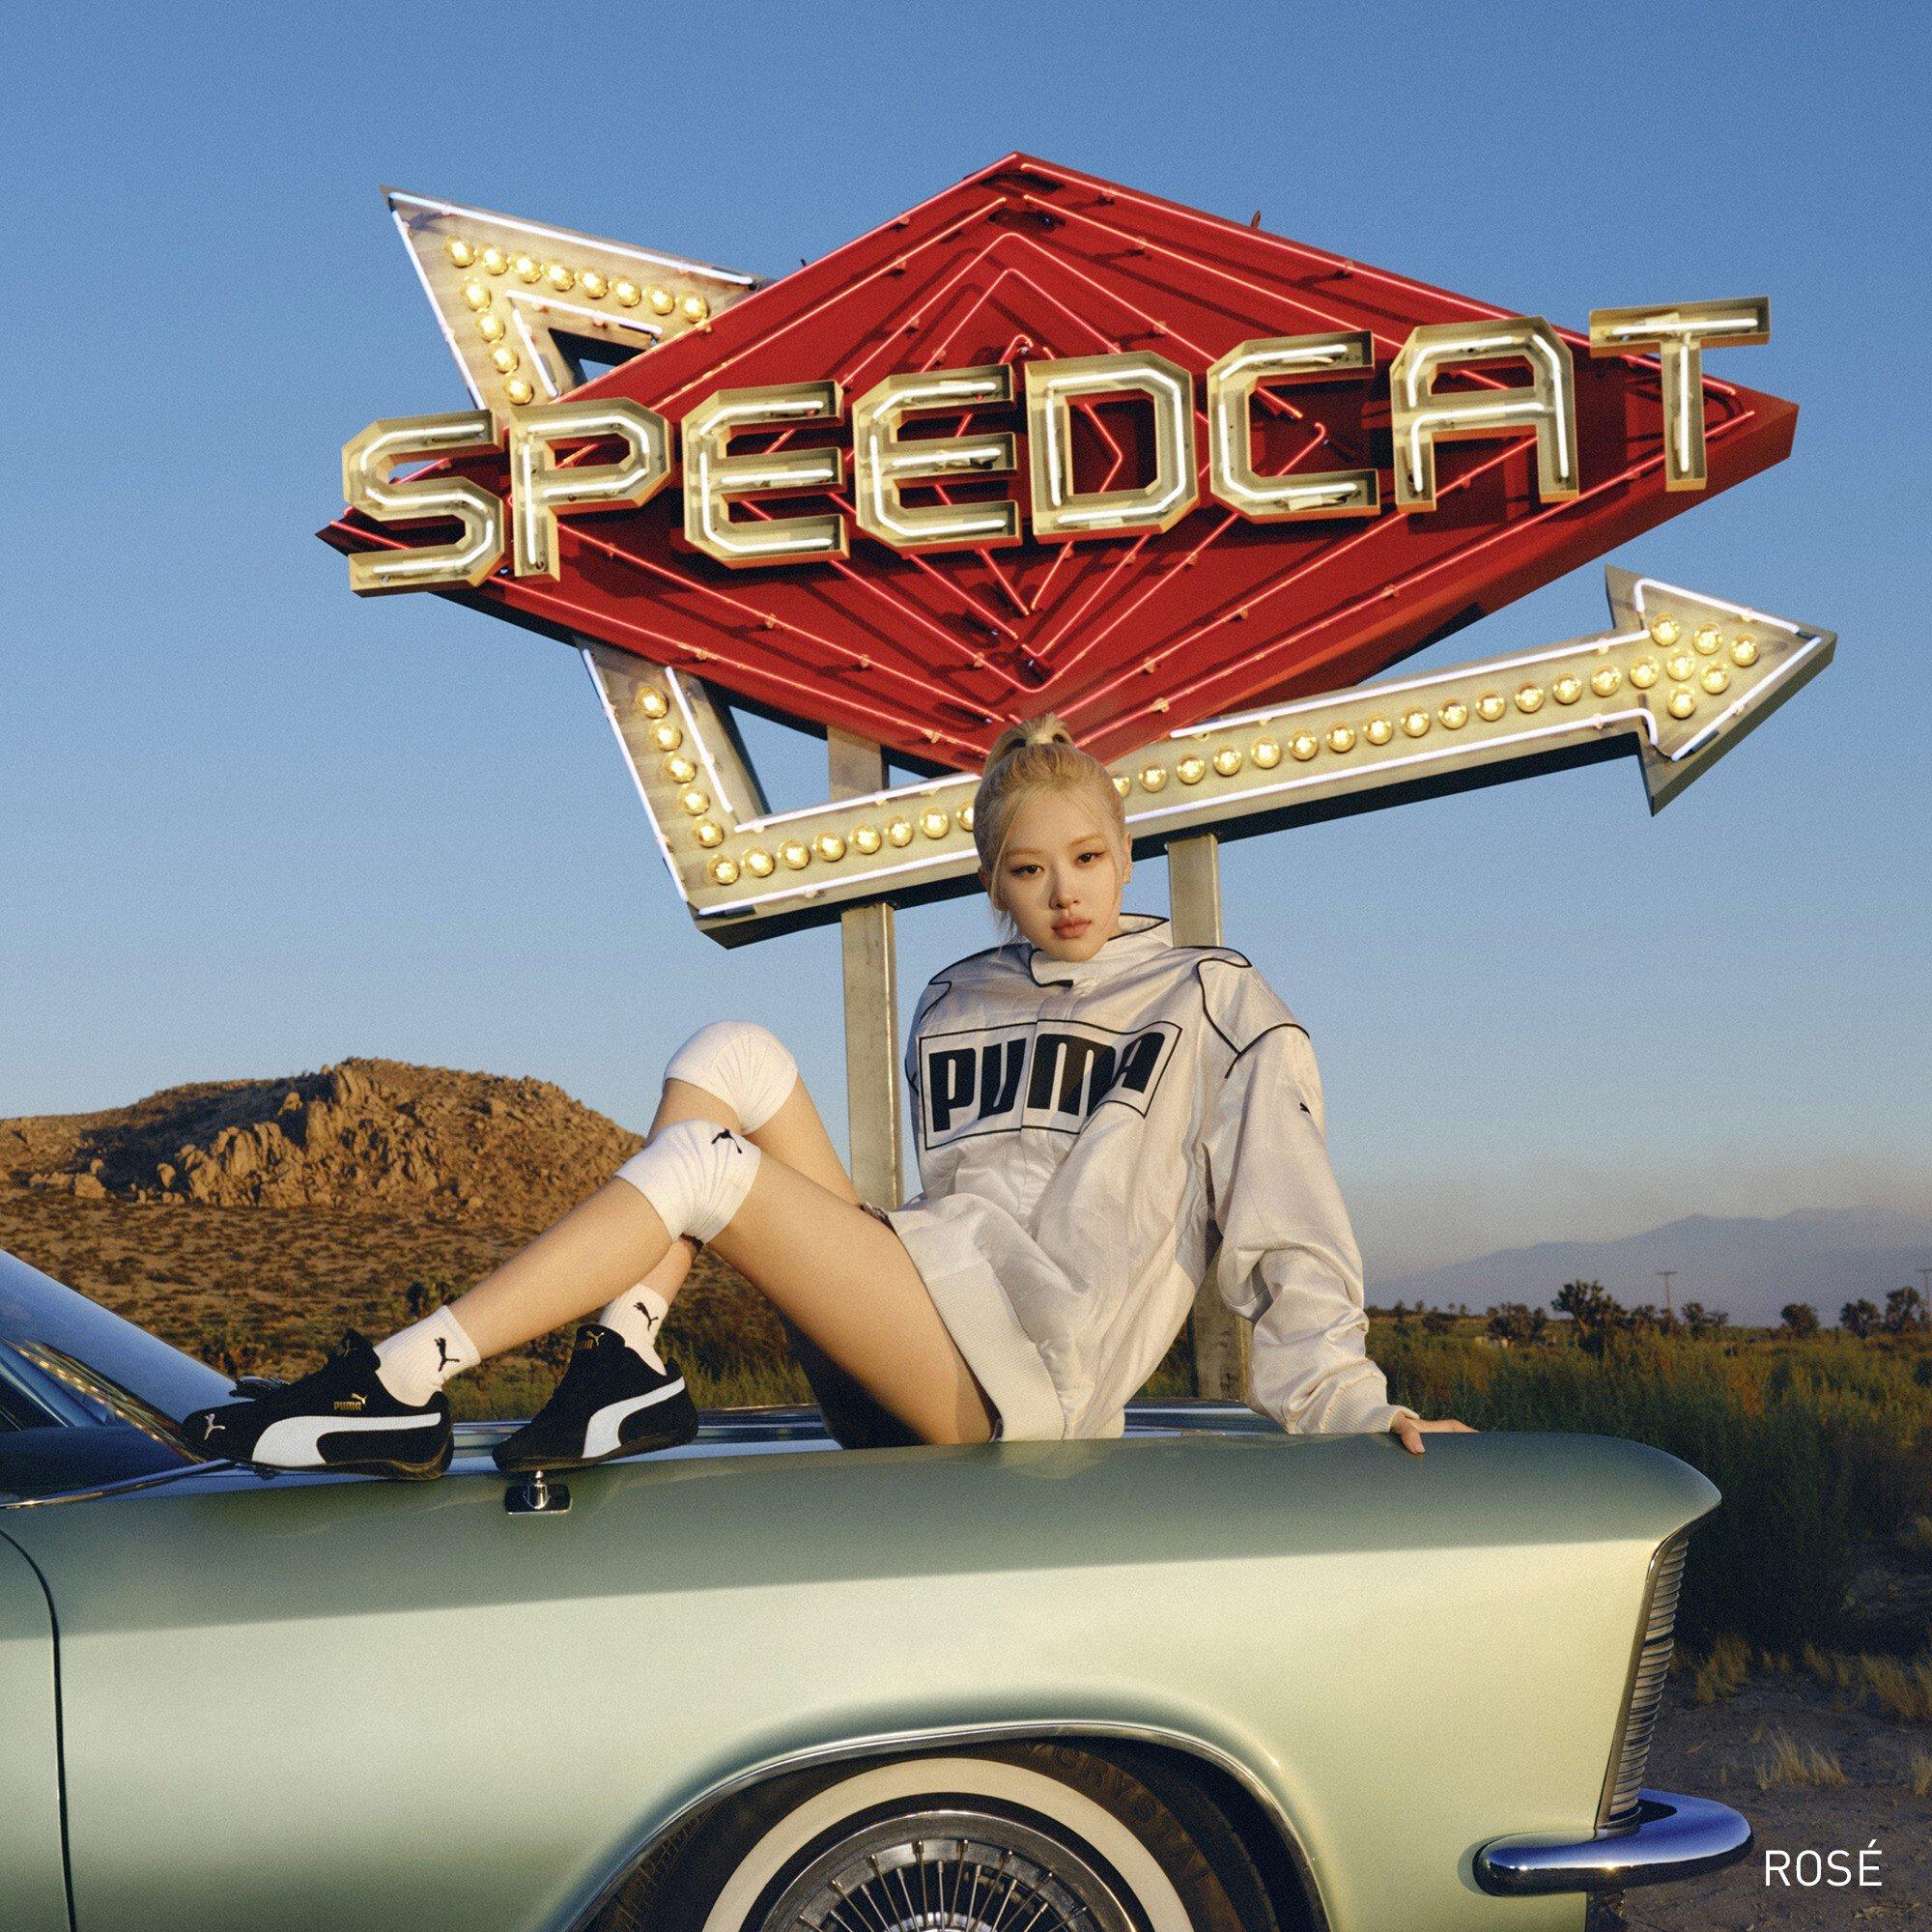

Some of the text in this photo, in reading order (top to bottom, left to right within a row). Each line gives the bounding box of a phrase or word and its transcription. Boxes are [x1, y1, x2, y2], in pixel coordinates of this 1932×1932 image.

[341, 296, 1771, 598] SPEEDCAT
[928, 1032, 1166, 1133] PUMA
[333, 1401, 362, 1411] PUMA
